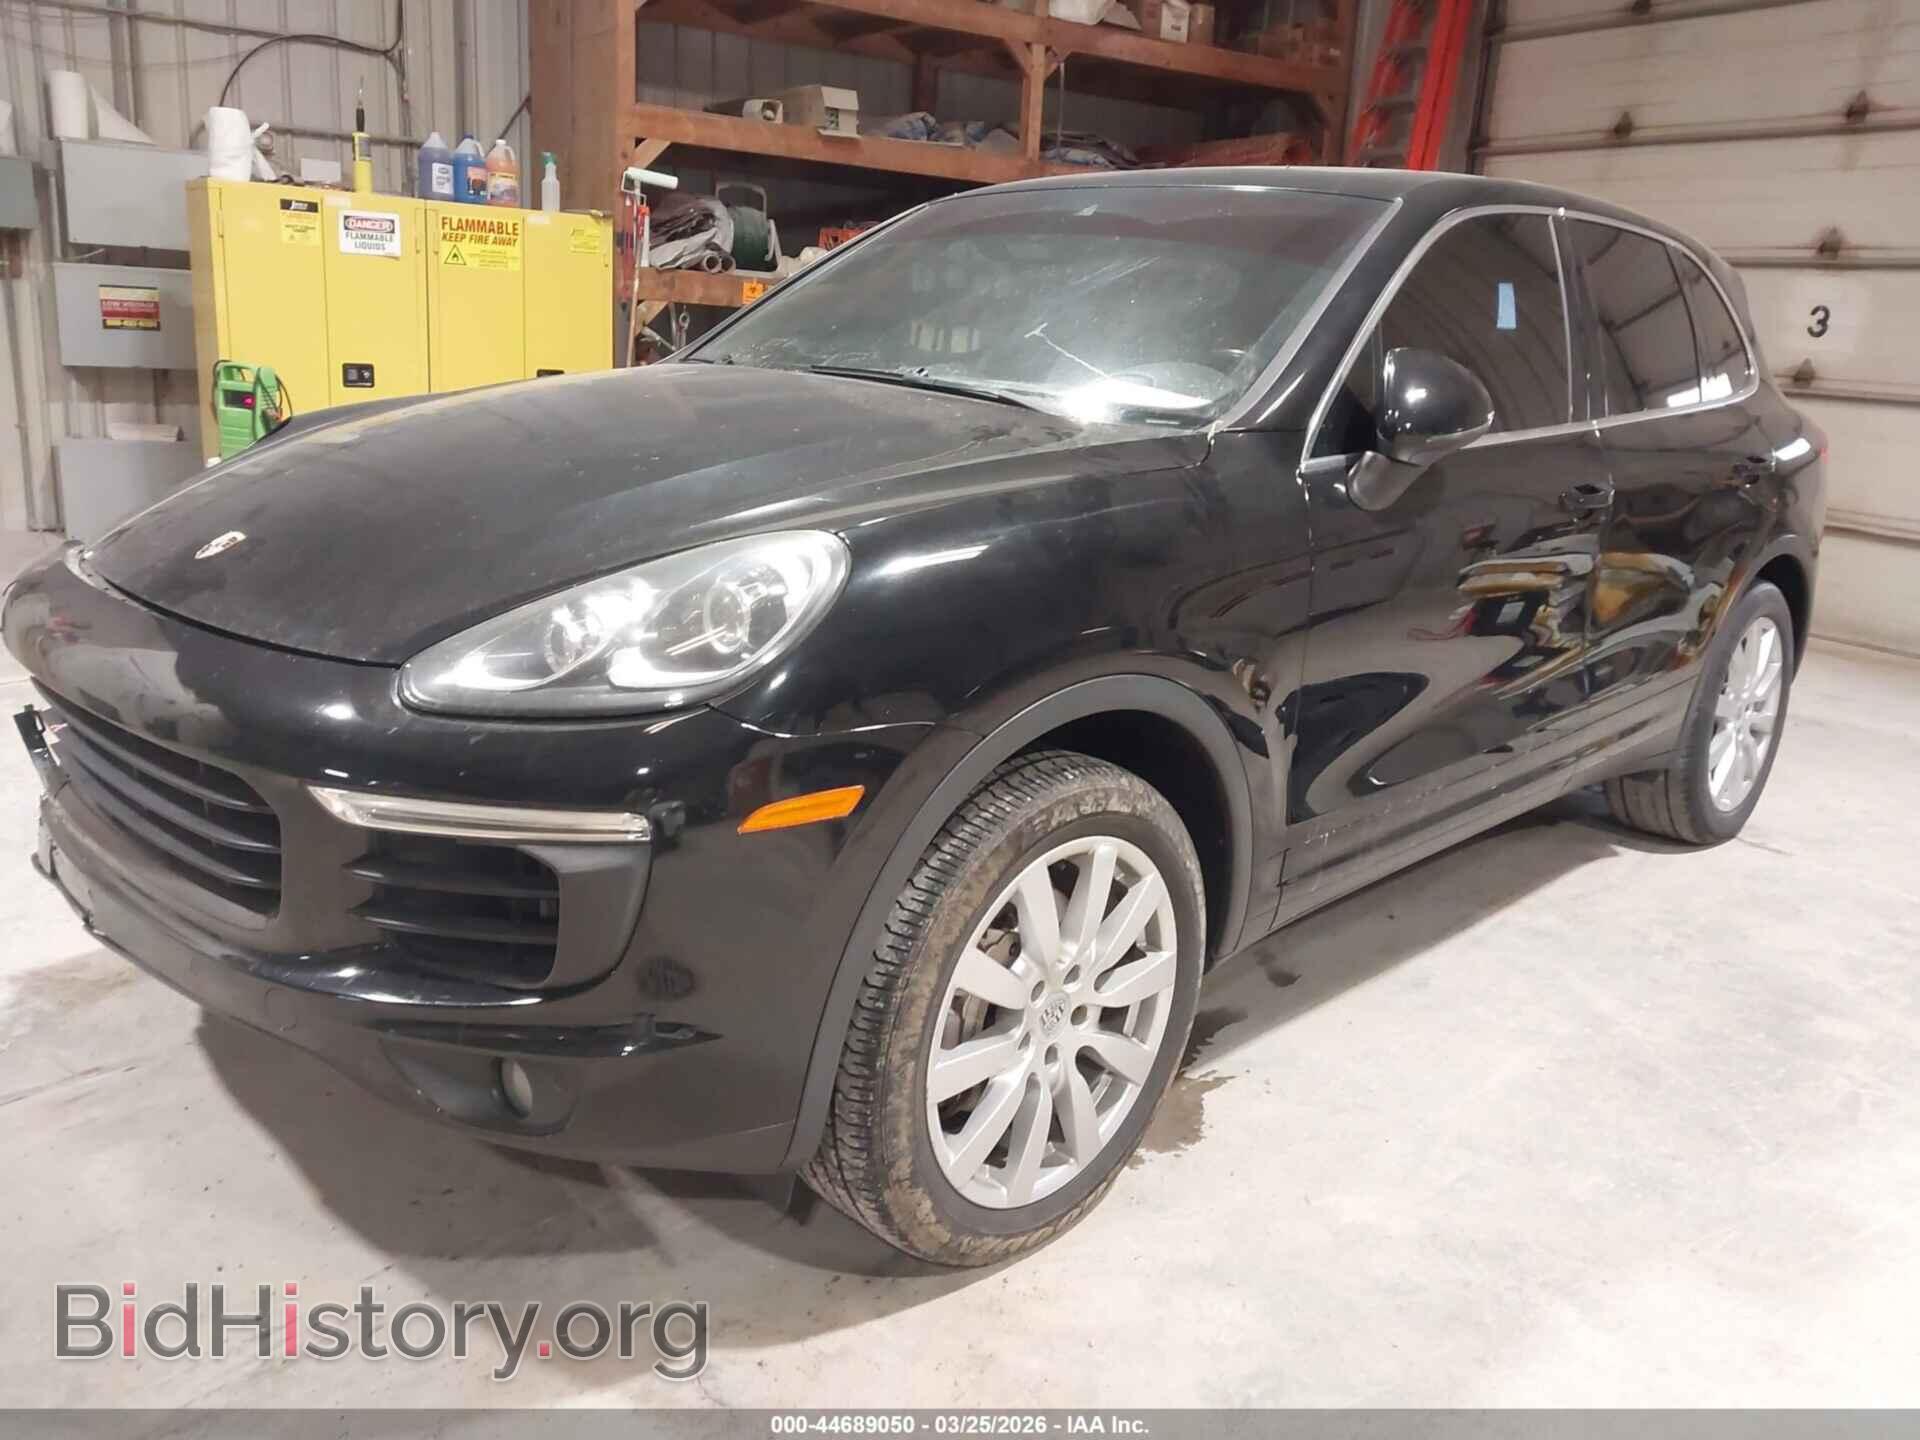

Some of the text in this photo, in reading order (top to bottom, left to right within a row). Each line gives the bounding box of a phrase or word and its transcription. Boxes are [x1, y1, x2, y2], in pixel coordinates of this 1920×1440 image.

[349, 217, 389, 231] DANGER
[441, 216, 519, 236] FLAMMABLE
[345, 231, 393, 242] FLAMMABLE
[441, 232, 518, 247] KEEP FIRE AWAY
[354, 241, 386, 250] LIQUIDS
[1807, 305, 1830, 338] 3
